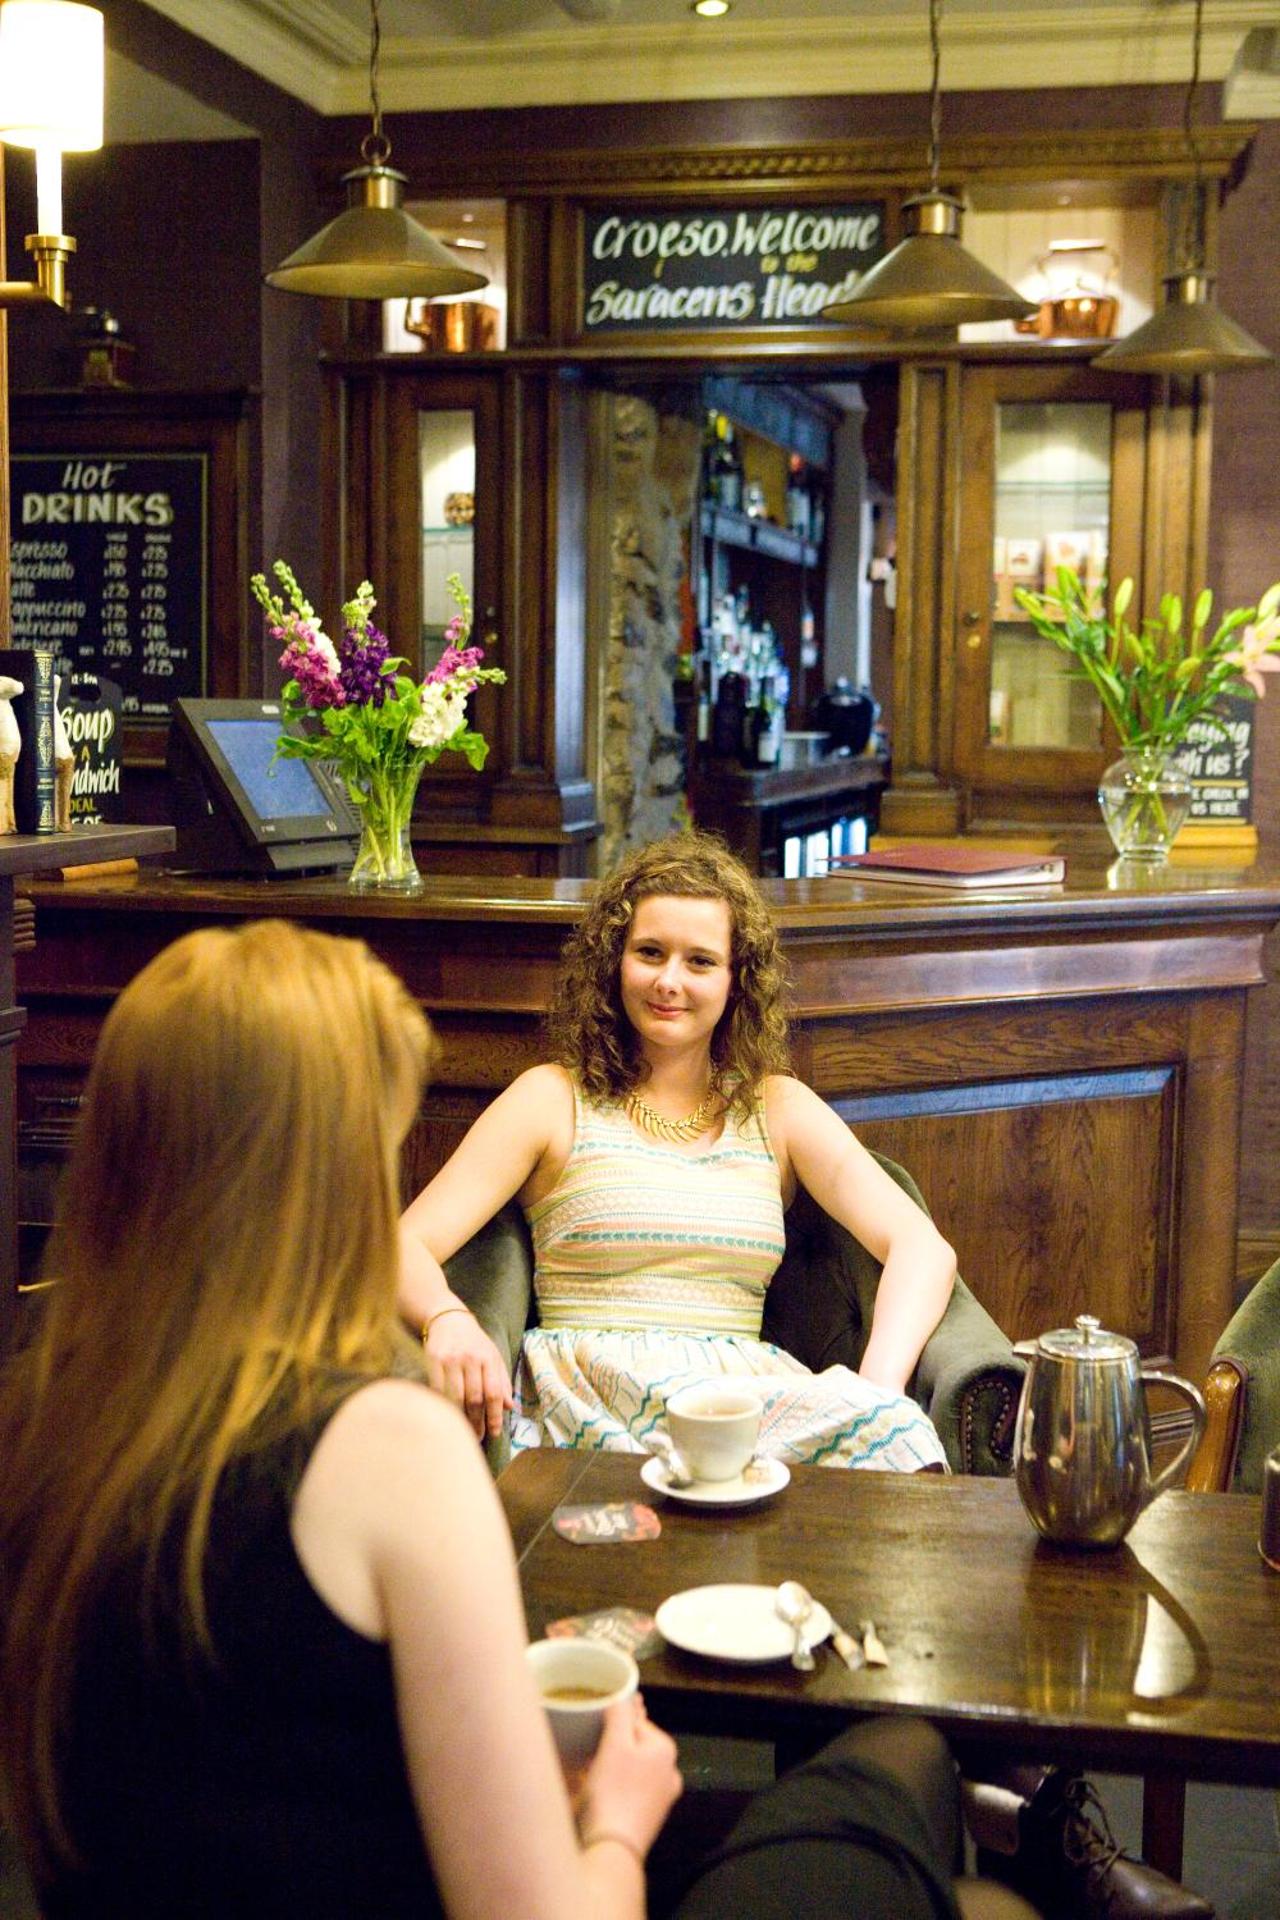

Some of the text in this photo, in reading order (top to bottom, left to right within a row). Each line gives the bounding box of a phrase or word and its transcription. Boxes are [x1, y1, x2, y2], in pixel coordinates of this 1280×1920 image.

[731, 211, 880, 257] Welcome
[586, 280, 754, 326] Saracens
[62, 461, 128, 490] Hot
[22, 492, 174, 526] DRINKS
[11, 541, 69, 563] spresso
[12, 601, 87, 625] appuccino
[61, 706, 114, 754] Soup
[70, 758, 120, 796] ndwich
